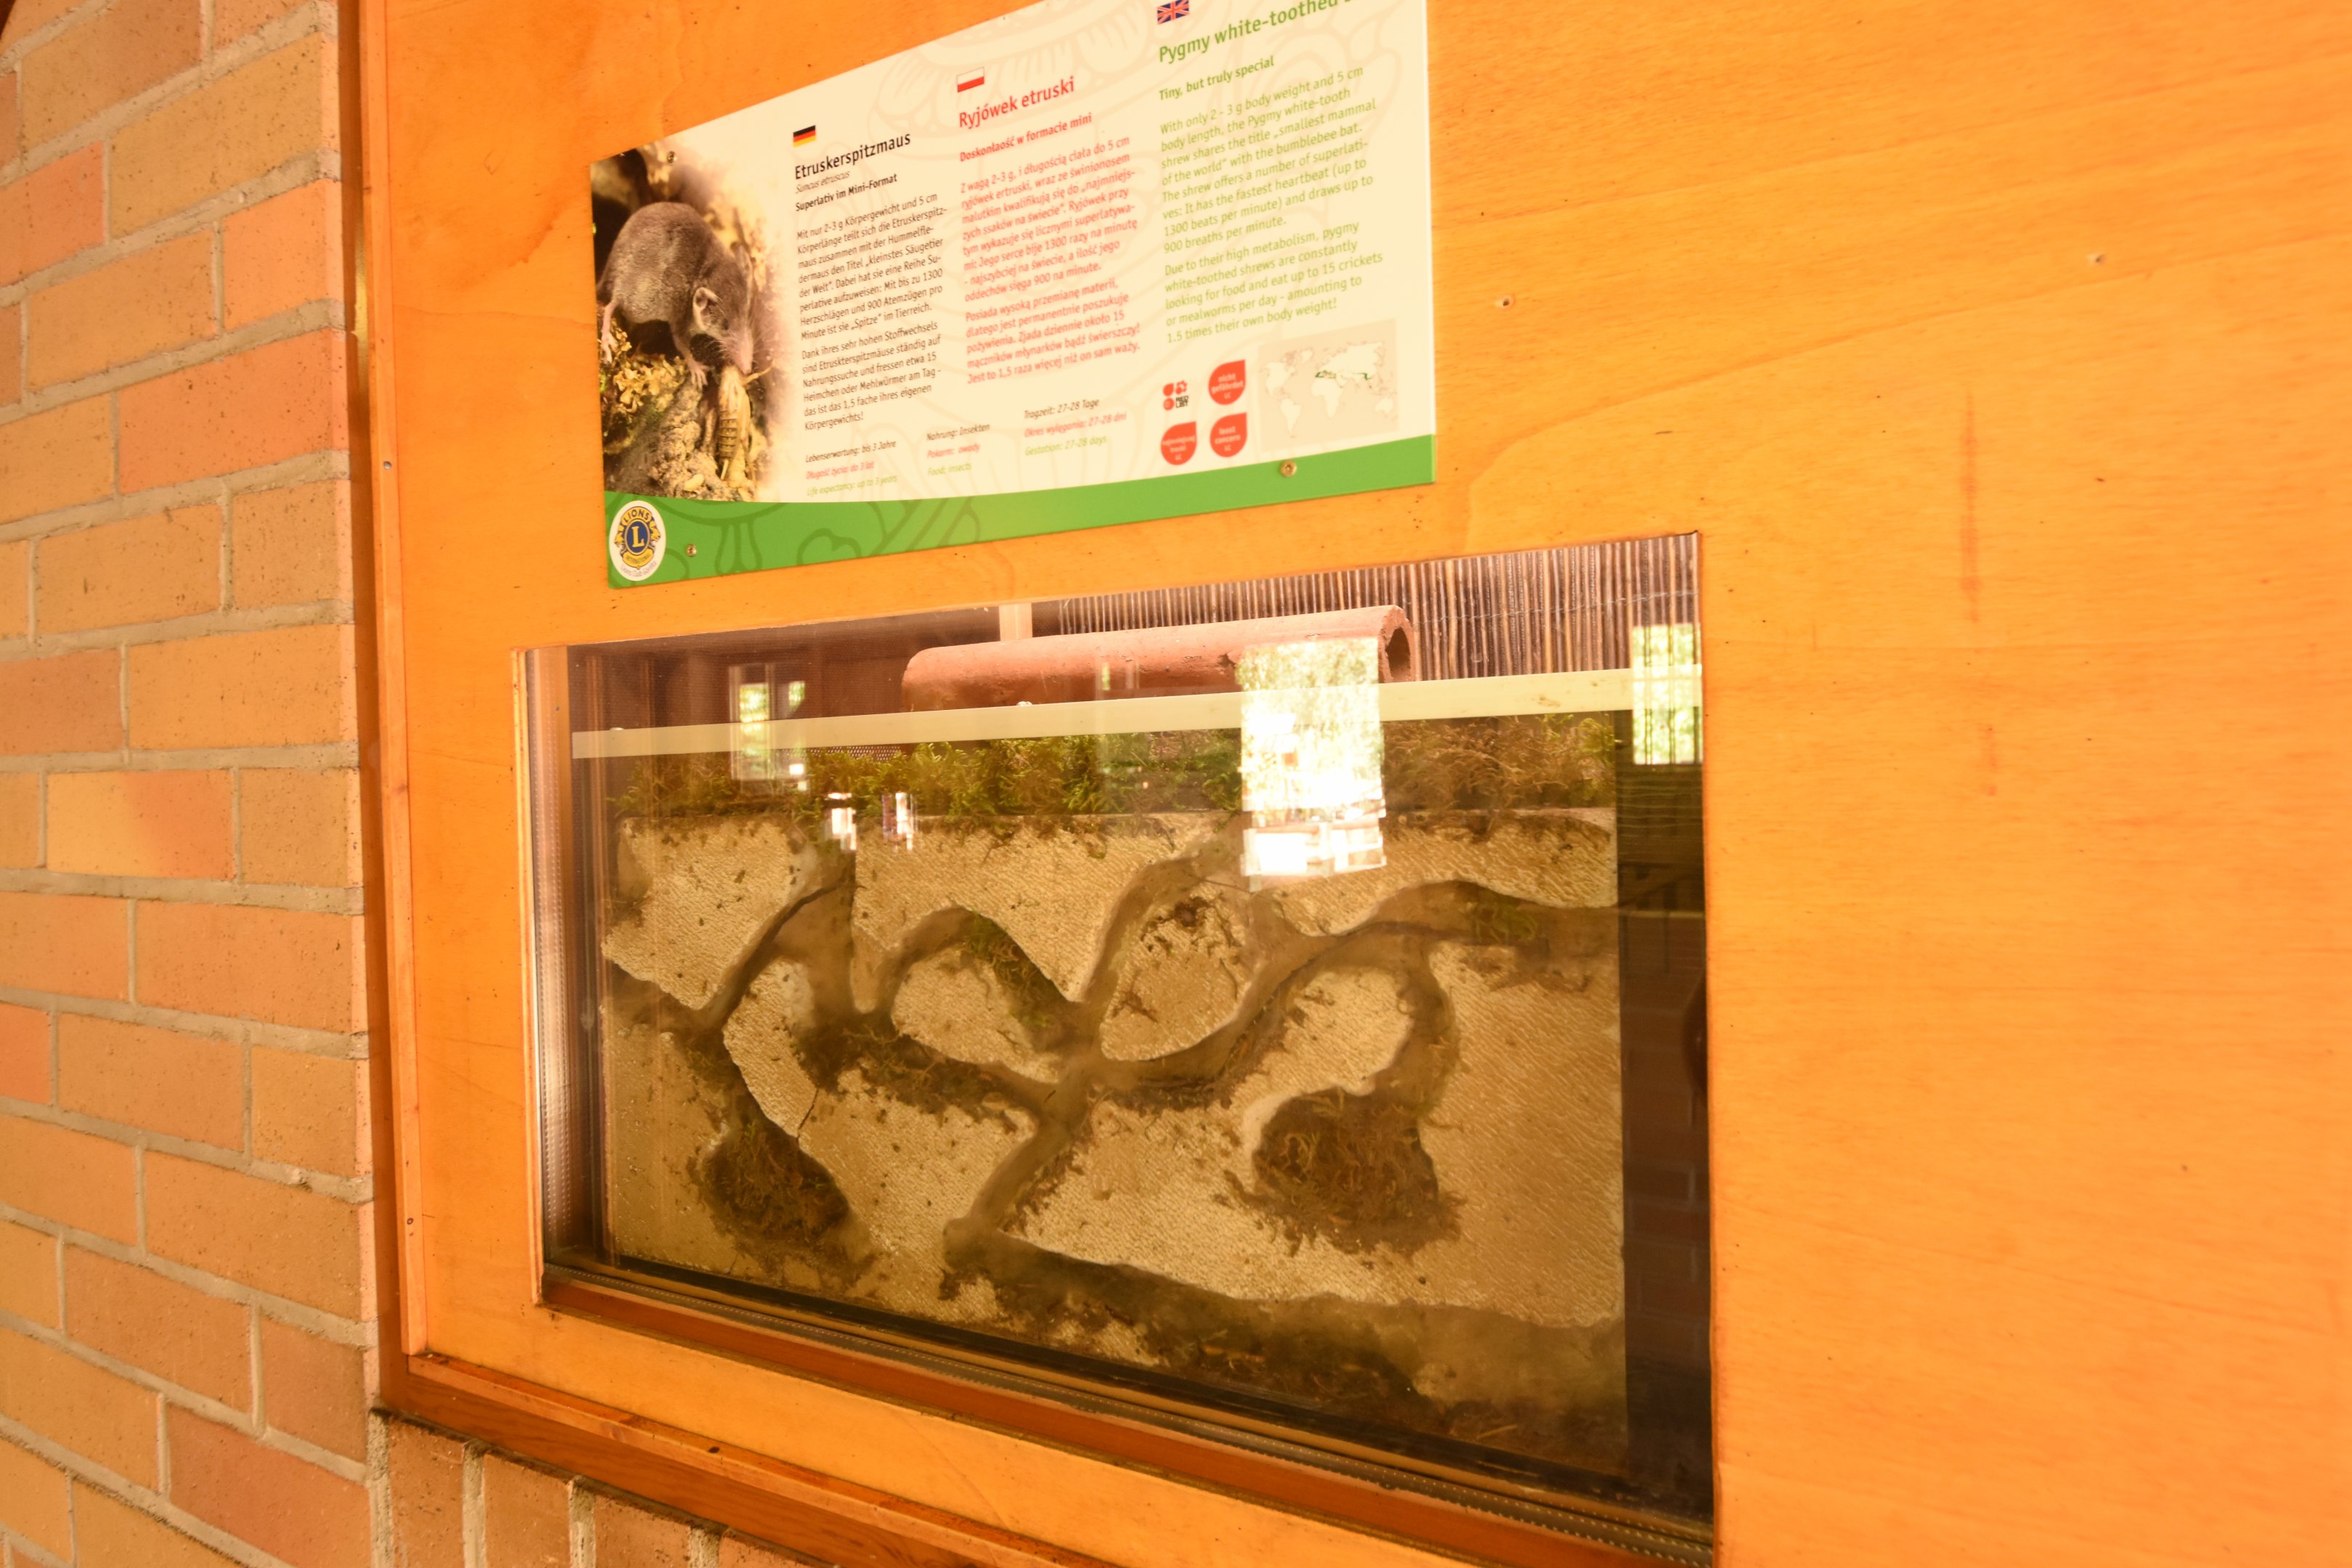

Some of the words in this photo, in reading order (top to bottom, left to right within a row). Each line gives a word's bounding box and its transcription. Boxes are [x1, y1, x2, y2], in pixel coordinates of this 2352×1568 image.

[1159, 34, 1210, 62] Pygmy
[1159, 88, 1183, 100] Tiny,
[1186, 78, 1204, 92] but
[1206, 70, 1233, 86] truly
[1235, 56, 1274, 78] special
[959, 94, 1017, 128] Ryjówek
[1021, 76, 1074, 107] etruski
[1160, 118, 1183, 134] With
[1185, 112, 1209, 127] only
[1209, 107, 1217, 120] 2
[1228, 103, 1233, 115] 3
[1236, 103, 1243, 115] g
[1245, 94, 1271, 110] body
[1273, 81, 1311, 102] weight
[1312, 73, 1334, 89] and
[1337, 70, 1344, 82] 5
[1347, 68, 1363, 80] cm
[1161, 136, 1185, 152] body
[1187, 124, 1225, 144] length,
[1227, 119, 1245, 132] the
[1247, 110, 1282, 128] Pygmy
[1284, 86, 1350, 116] white-tooth
[1161, 153, 1191, 168] shrew
[1193, 143, 1225, 160] shares
[1228, 136, 1246, 150] the
[1247, 130, 1270, 144] title
[1327, 98, 1376, 122] mammal
[795, 135, 910, 179] Etruskerspitzmaus
[1161, 172, 1172, 185] of
[1174, 169, 1191, 182] the
[1230, 150, 1252, 167] with
[1255, 147, 1274, 160] the
[1275, 130, 1338, 155] bumblebee
[1338, 123, 1362, 137] bat.
[796, 192, 834, 211] Superlativ
[836, 190, 846, 199] im
[848, 173, 897, 195] Mini-Format
[797, 236, 842, 254] Körperlänge
[844, 229, 859, 241] teilt
[861, 224, 876, 237] sich
[878, 221, 891, 232] die
[892, 207, 947, 228] Etruskerspitz-
[1163, 239, 1183, 253] 900
[1185, 230, 1223, 248] breaths
[1226, 226, 1243, 241] per
[1245, 217, 1286, 233] minute.
[1164, 264, 1185, 276] Due
[1185, 261, 1196, 271] to
[1199, 253, 1225, 268] their
[1225, 245, 1249, 262] high
[1252, 232, 1318, 255] metabolism,
[1323, 222, 1359, 241] pygmy
[799, 269, 829, 283] dermaus
[830, 265, 845, 274] den
[846, 257, 863, 271] Titel
[833, 284, 881, 303] aufzuweisen:
[884, 279, 897, 290] Mit
[898, 277, 910, 287] bis
[912, 275, 920, 284] zu
[923, 267, 943, 281] 1300
[1164, 266, 1237, 293] white-toothed
[1240, 260, 1275, 275] shrews
[1278, 255, 1296, 266] are
[1298, 240, 1357, 262] constantly
[801, 328, 826, 340] Minute
[827, 324, 837, 334] ist
[838, 321, 849, 332] sie
[883, 311, 894, 321] im
[895, 301, 932, 318] Tierreich.
[1167, 329, 1183, 343] 1.5
[1185, 326, 1212, 339] times
[1215, 318, 1239, 332] their
[1243, 315, 1264, 327] own
[1267, 308, 1293, 322] body
[1295, 297, 1336, 316] weight!
[802, 362, 817, 373] sind
[896, 338, 926, 353] ständig
[928, 334, 941, 346] auf
[803, 368, 858, 388] Nahrungssuche
[860, 364, 875, 375] und
[876, 360, 904, 372] fressen
[906, 355, 925, 365] etwa
[927, 350, 936, 361] 15
[804, 410, 863, 430] Körpergewichts!
[624, 509, 650, 523] LIONS
[632, 526, 645, 548] L
